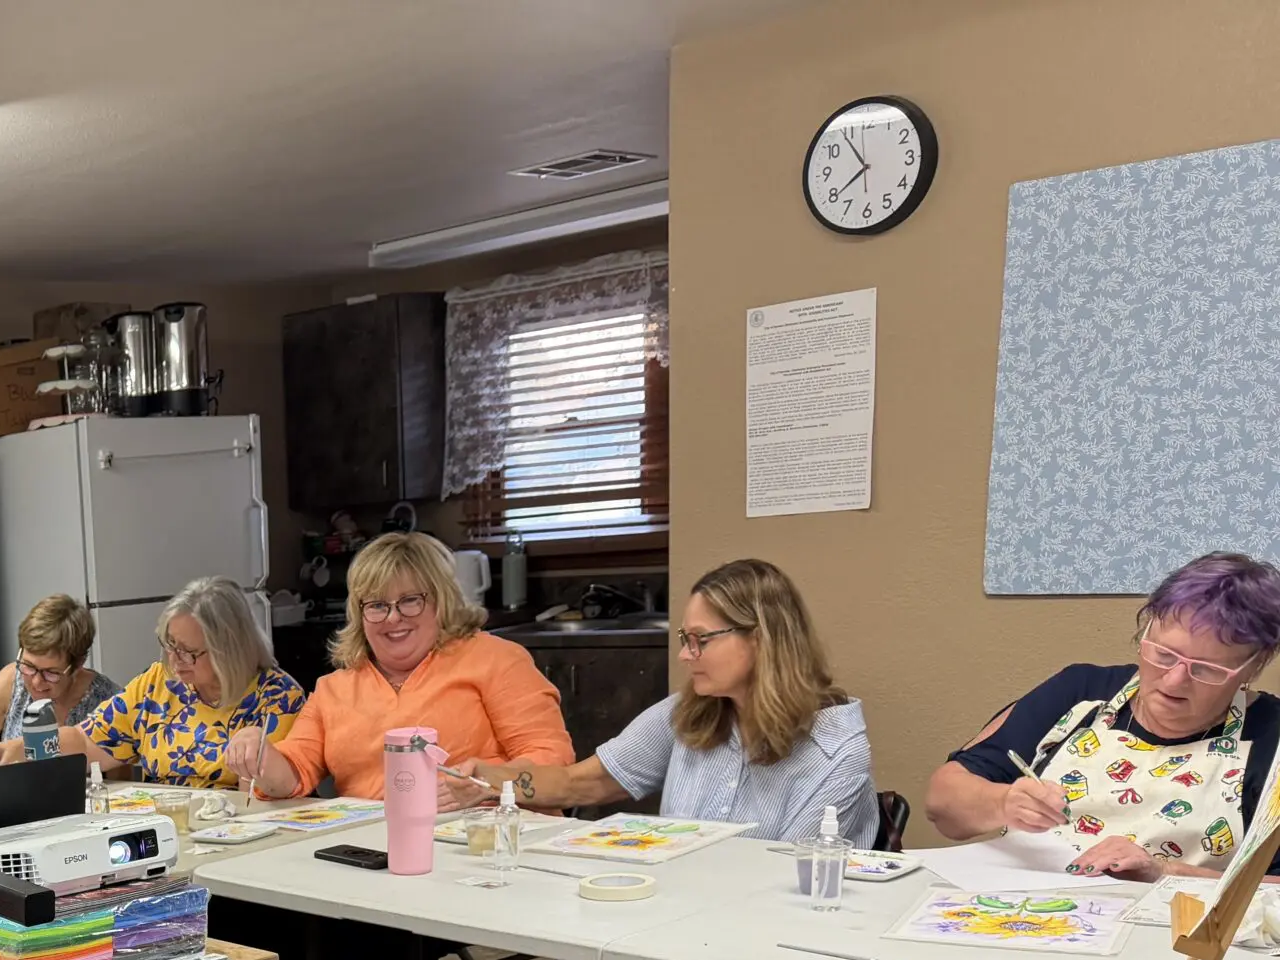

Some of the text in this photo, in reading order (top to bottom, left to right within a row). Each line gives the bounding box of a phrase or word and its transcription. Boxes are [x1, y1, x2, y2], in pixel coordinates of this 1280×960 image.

[899, 128, 909, 145] 2
[827, 144, 840, 160] 10
[904, 149, 915, 166] 3
[822, 166, 832, 182] 9
[897, 174, 908, 190] 4
[828, 187, 838, 203] 8
[882, 193, 892, 210] 5
[843, 199, 853, 216] 7
[862, 202, 872, 218] 6
[64, 853, 88, 865] EPSON
